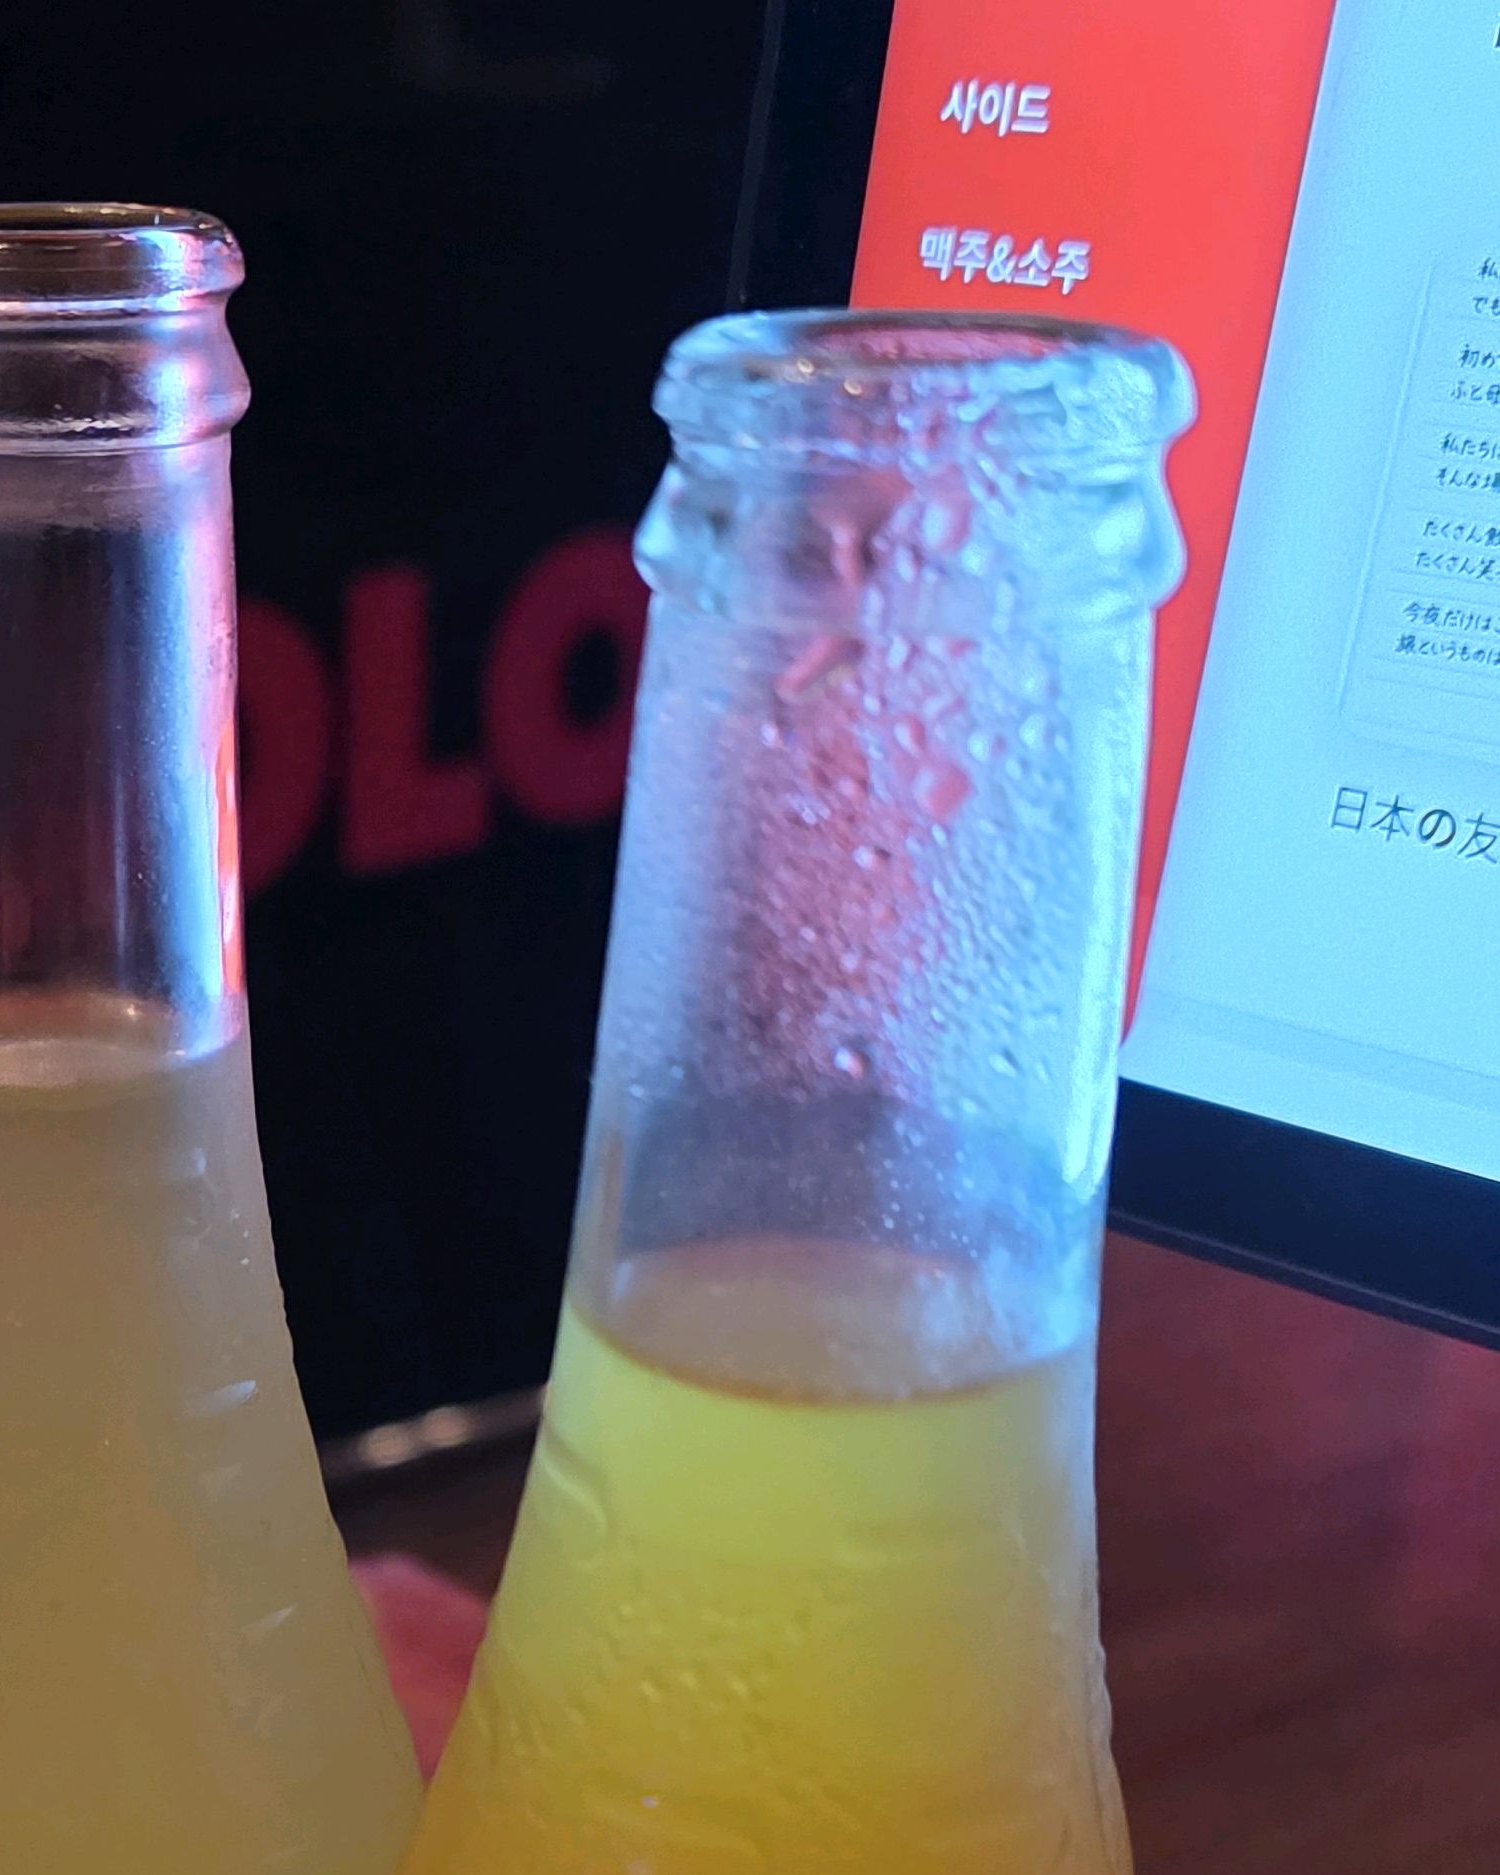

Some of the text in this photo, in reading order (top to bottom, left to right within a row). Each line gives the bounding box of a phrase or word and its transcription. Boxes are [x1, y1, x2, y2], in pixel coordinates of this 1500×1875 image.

[941, 77, 1050, 137] 사이드
[920, 225, 1091, 296] 맥주&소주
[1331, 786, 1500, 864] 日本の友
